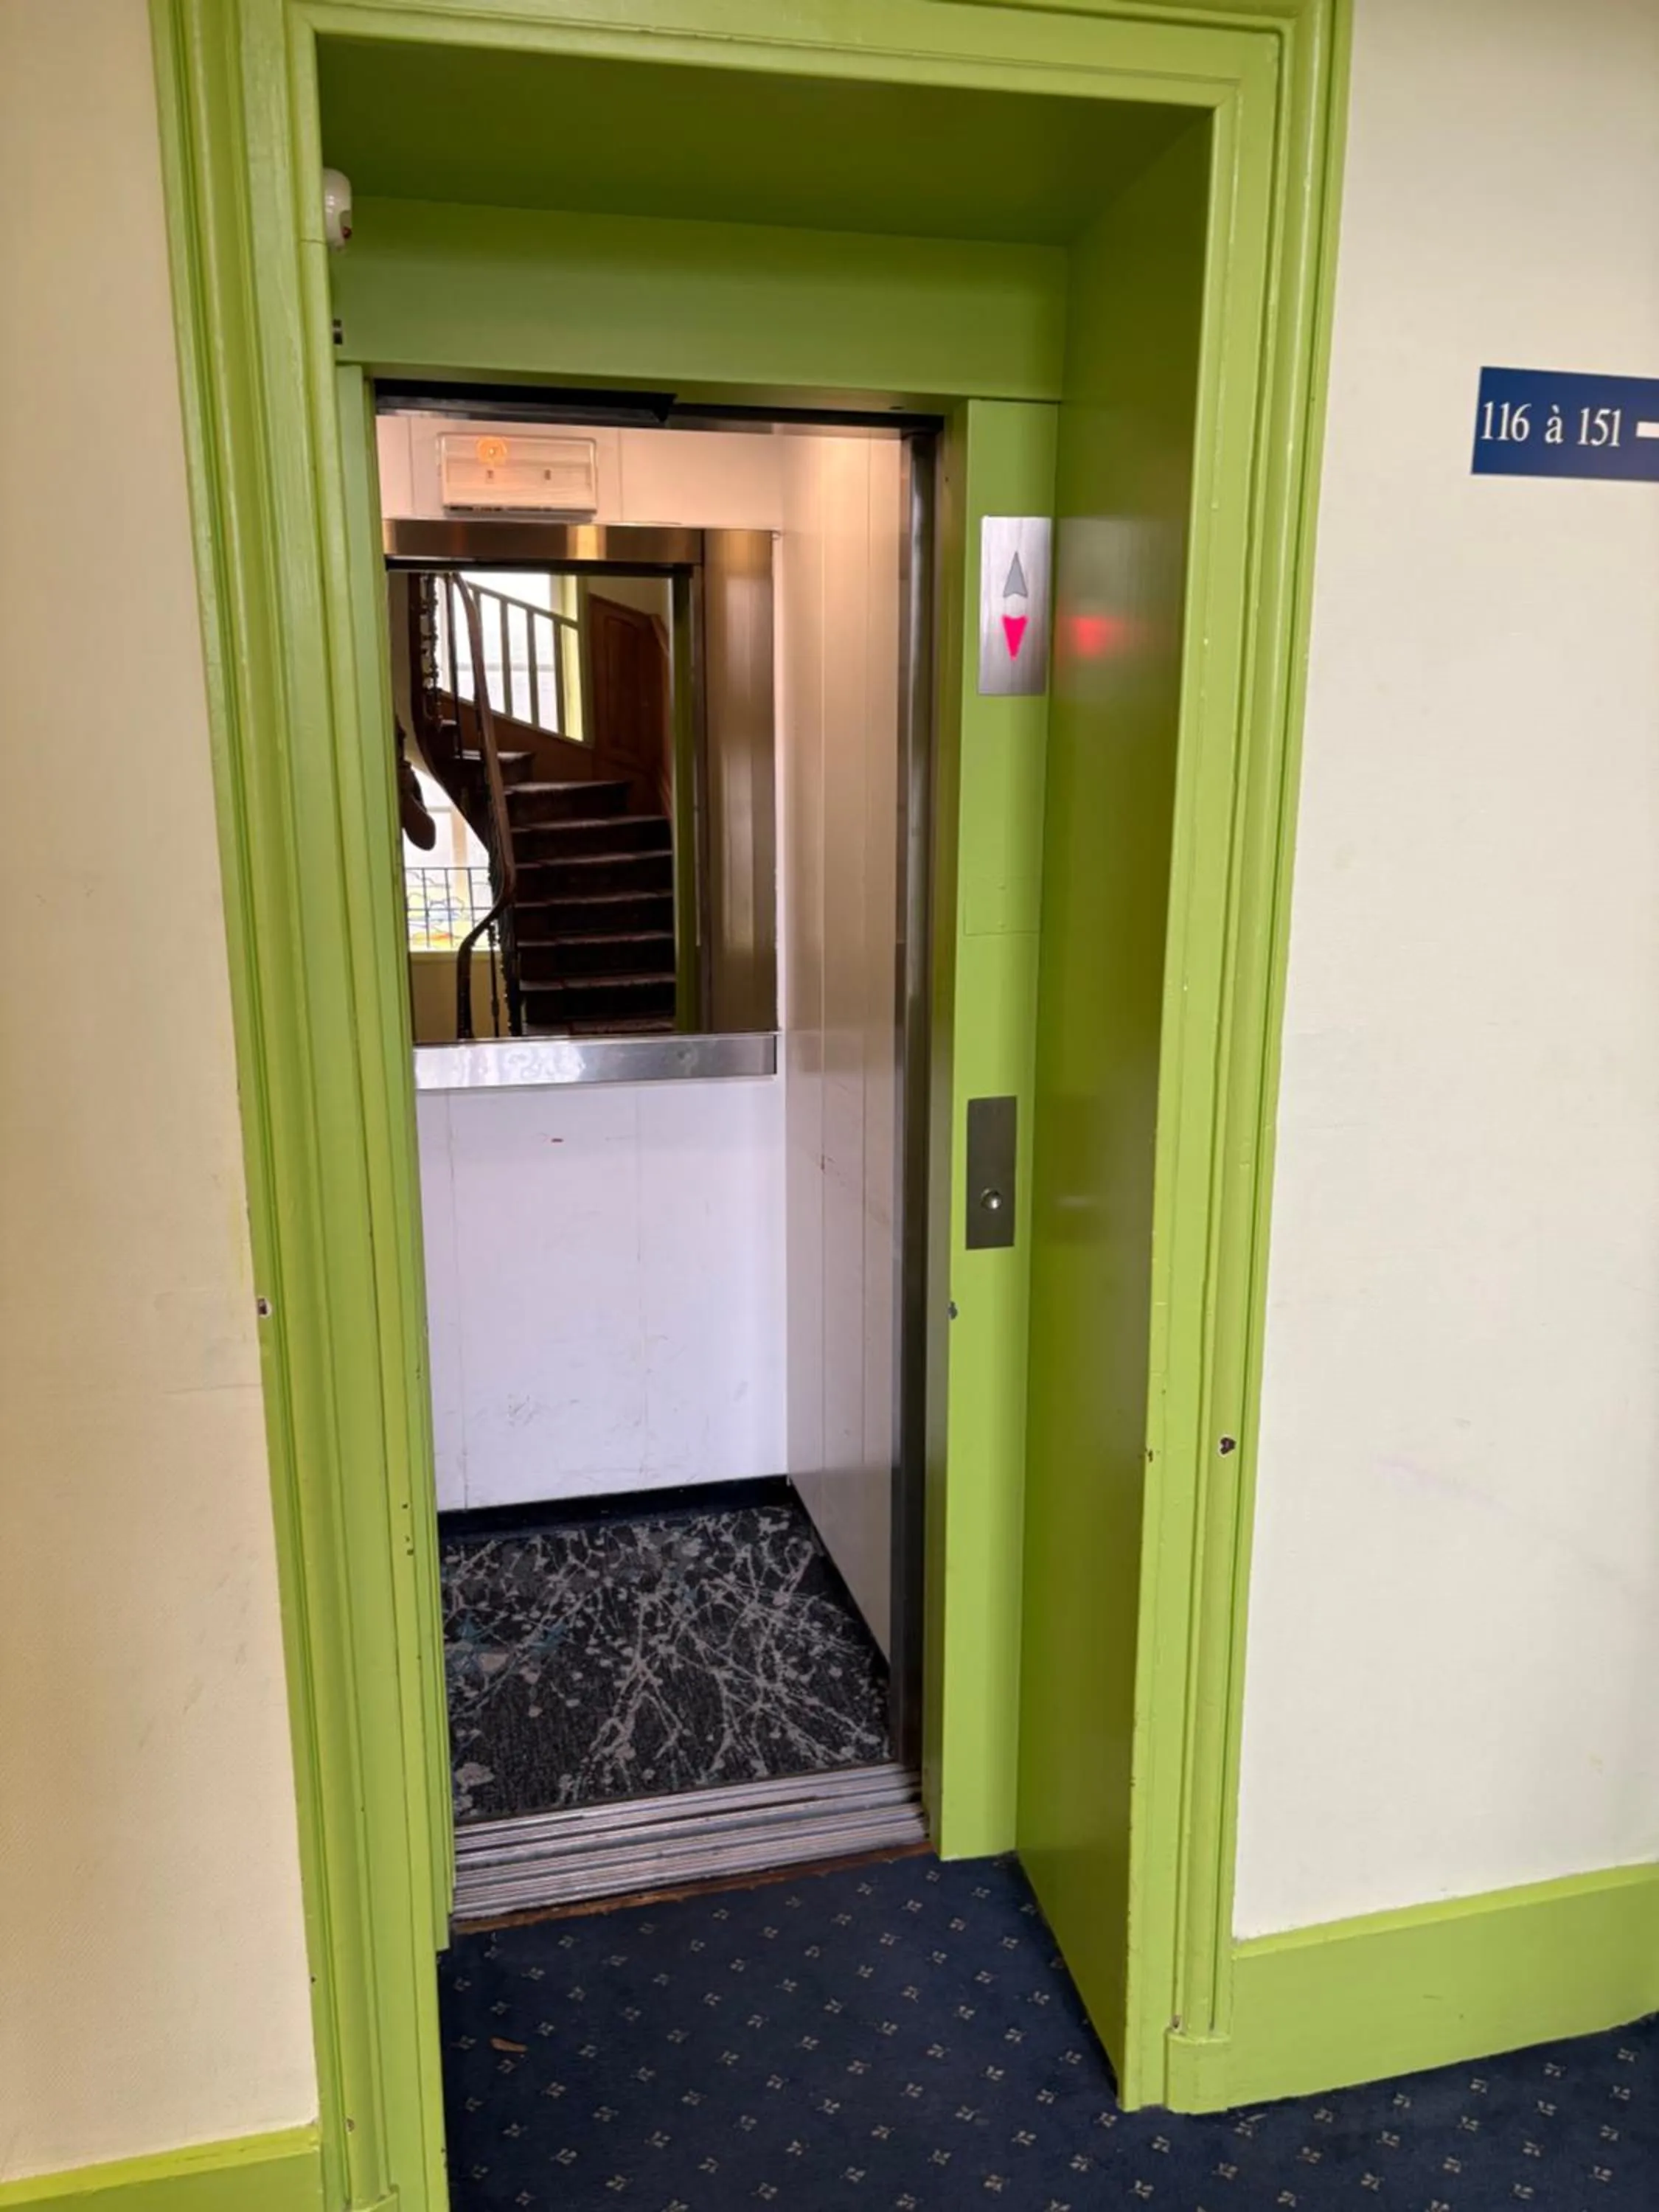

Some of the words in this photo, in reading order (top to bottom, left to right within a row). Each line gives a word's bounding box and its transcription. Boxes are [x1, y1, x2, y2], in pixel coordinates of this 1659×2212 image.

[1481, 400, 1532, 442] 116
[1544, 404, 1564, 445] à
[1576, 407, 1621, 447] 151
